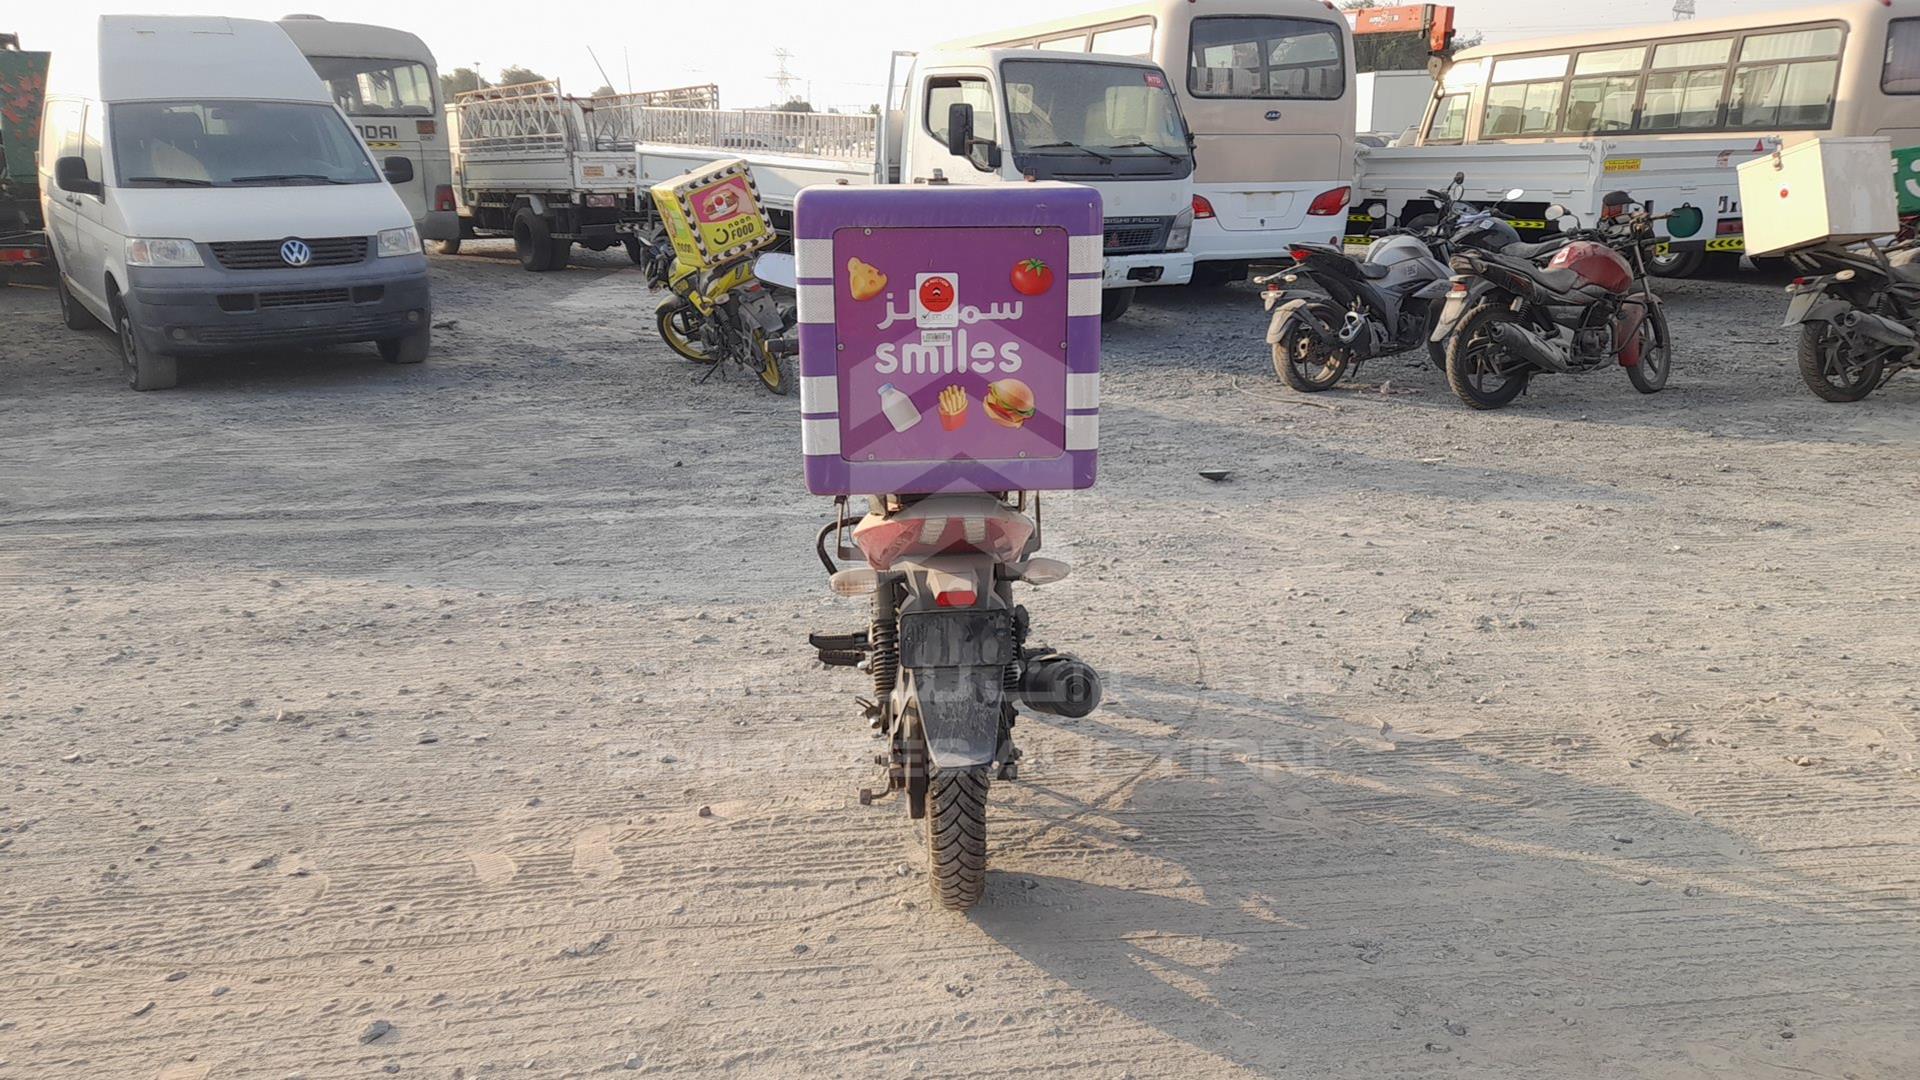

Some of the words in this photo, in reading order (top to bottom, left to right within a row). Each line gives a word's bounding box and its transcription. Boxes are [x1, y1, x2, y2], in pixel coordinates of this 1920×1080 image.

[728, 216, 752, 229] noon
[731, 222, 754, 240] FOOD
[875, 328, 1023, 374] smiles
